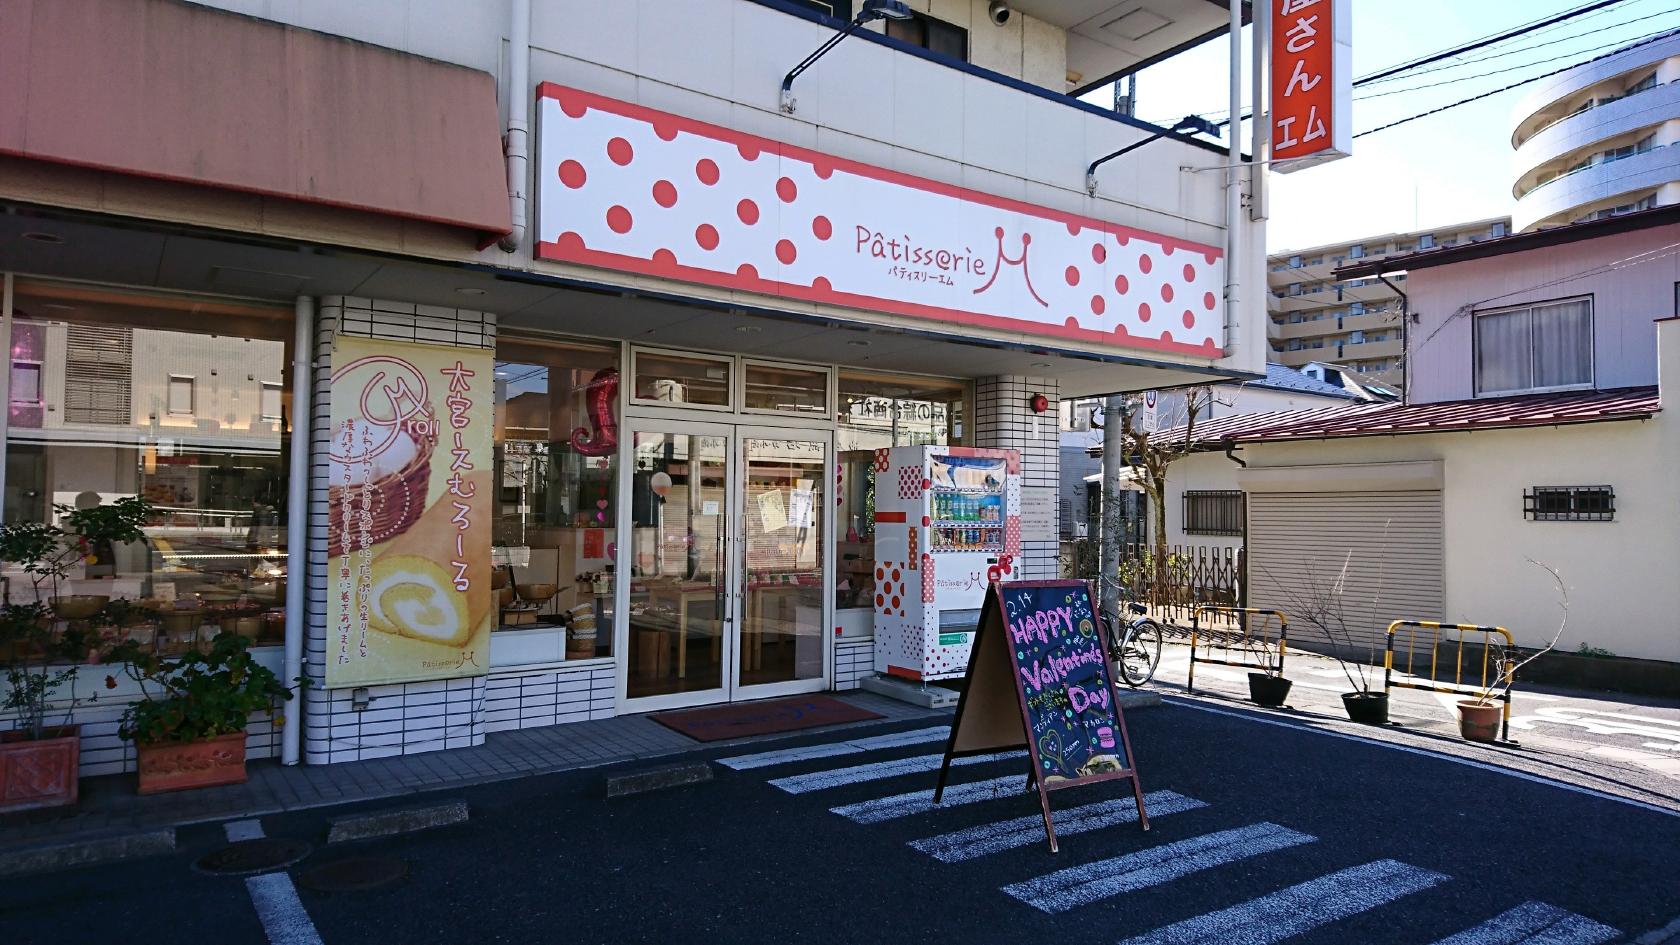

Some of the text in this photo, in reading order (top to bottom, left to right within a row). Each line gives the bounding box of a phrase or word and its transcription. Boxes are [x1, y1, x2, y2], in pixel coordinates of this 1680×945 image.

[1275, 106, 1327, 151] エム
[888, 266, 954, 286] パティスリーエム
[407, 419, 440, 436] roll
[1006, 592, 1032, 618] 2.14
[1009, 606, 1074, 645] HAPPY
[1068, 687, 1109, 714] Day
